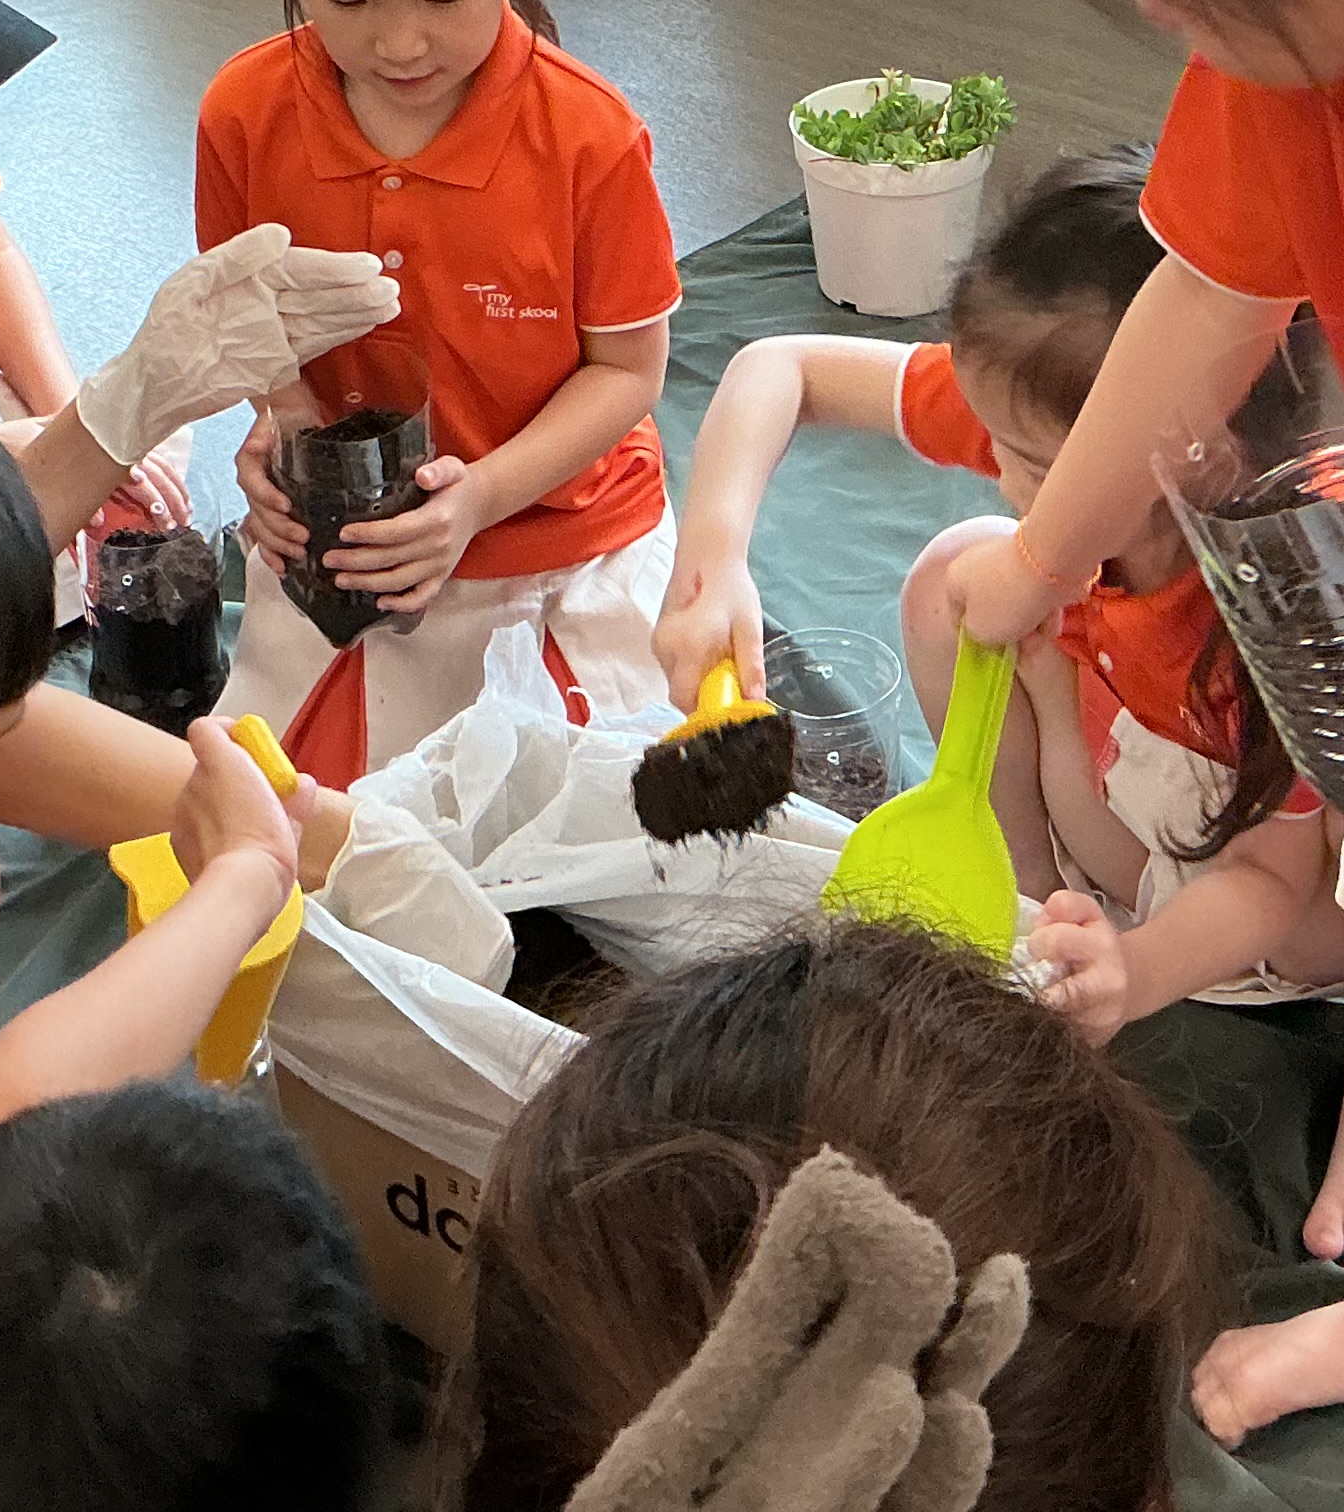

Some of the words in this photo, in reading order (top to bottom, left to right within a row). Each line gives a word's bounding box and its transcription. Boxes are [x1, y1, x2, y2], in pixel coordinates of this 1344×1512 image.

[487, 292, 513, 307] my
[485, 302, 515, 319] first
[518, 305, 558, 320] skool
